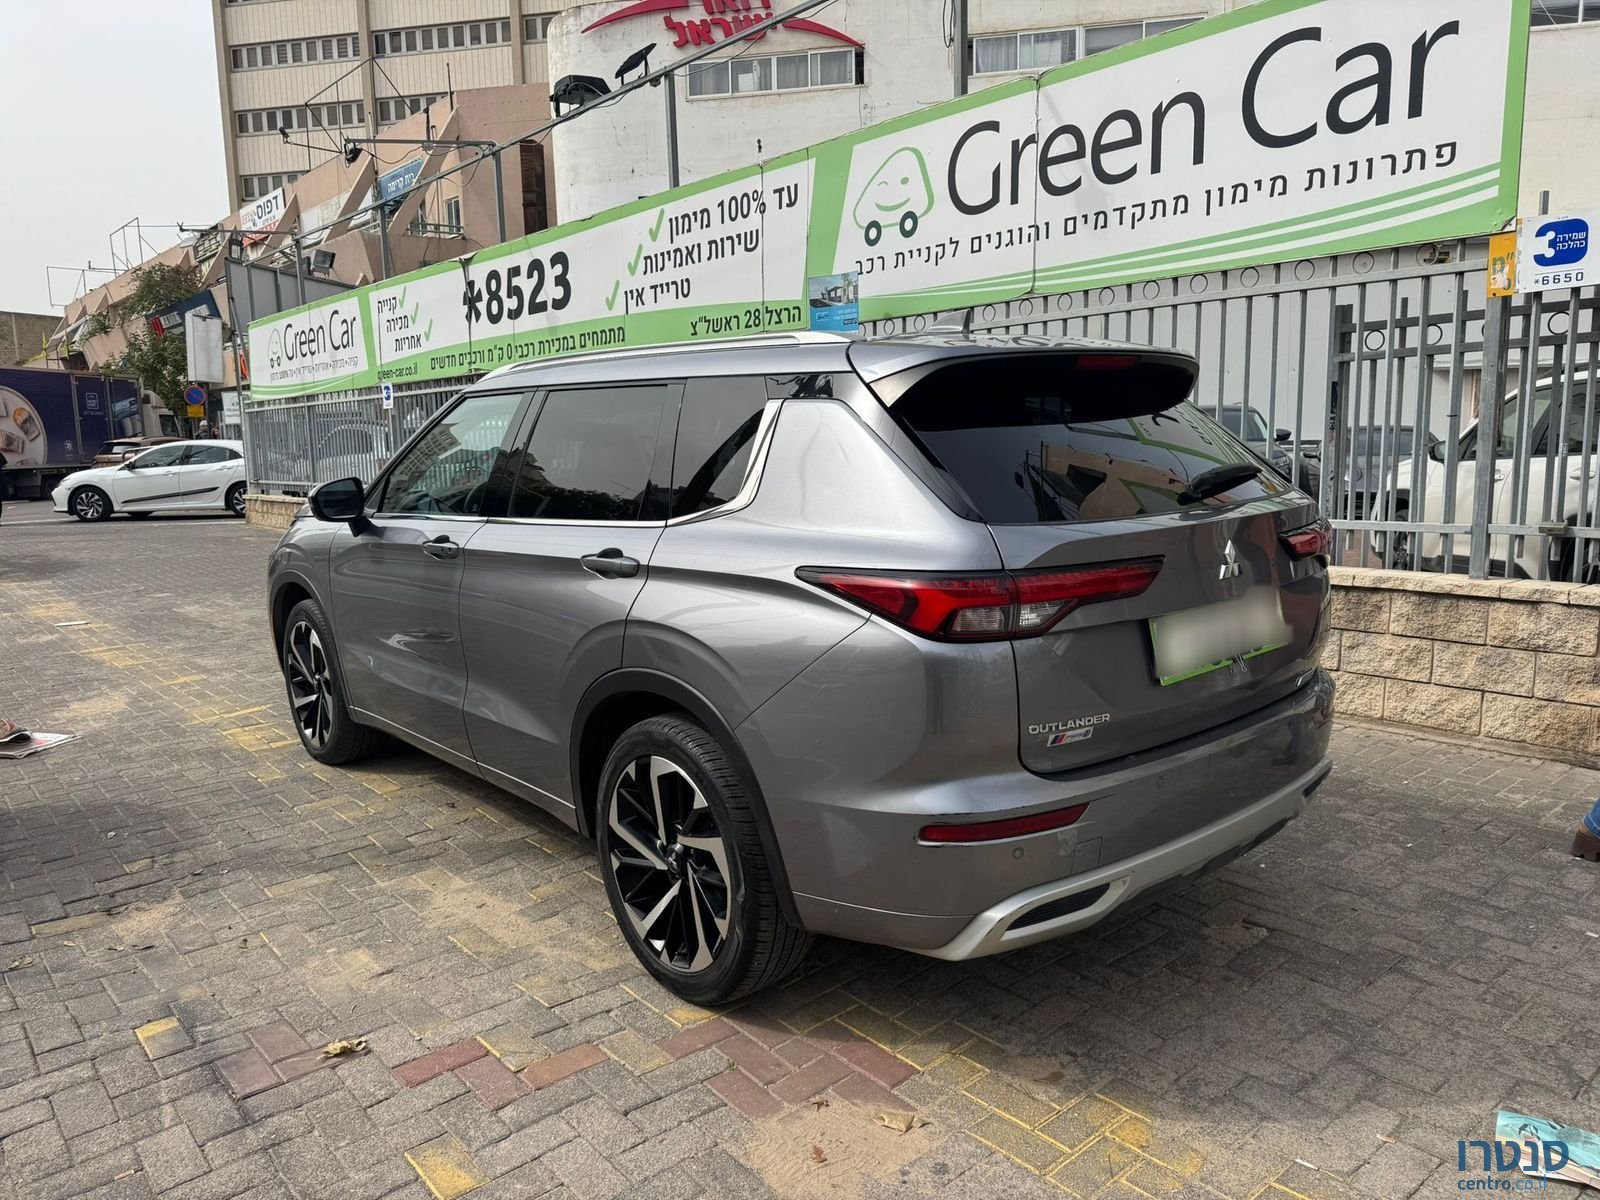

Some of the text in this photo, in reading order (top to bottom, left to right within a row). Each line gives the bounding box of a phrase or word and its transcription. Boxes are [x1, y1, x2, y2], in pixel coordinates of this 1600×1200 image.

[947, 19, 1460, 216] Green Car
[256, 194, 279, 220] דפוס
[668, 183, 799, 244] עד 100% מימון
[855, 141, 1457, 276] פתרונות מימון מתקדמים והוגנים לקניית רכב
[1556, 231, 1586, 243] שמירה
[1556, 240, 1586, 250] כהלכה
[643, 229, 759, 276] שירות ואמינות
[377, 296, 397, 315] קנייה
[624, 277, 691, 316] טרייד אין
[386, 315, 409, 333] מכירה
[744, 308, 761, 329] 28
[765, 305, 802, 326] הרצל
[284, 309, 356, 361] Green Car
[394, 333, 422, 353] אחריות
[579, 326, 626, 349] מתמחים
[514, 343, 535, 359] רכבי
[538, 336, 577, 356] במכירת
[430, 354, 456, 371] חדשים
[458, 349, 486, 367] ורכבים
[1028, 713, 1111, 735] OUTLANDER
